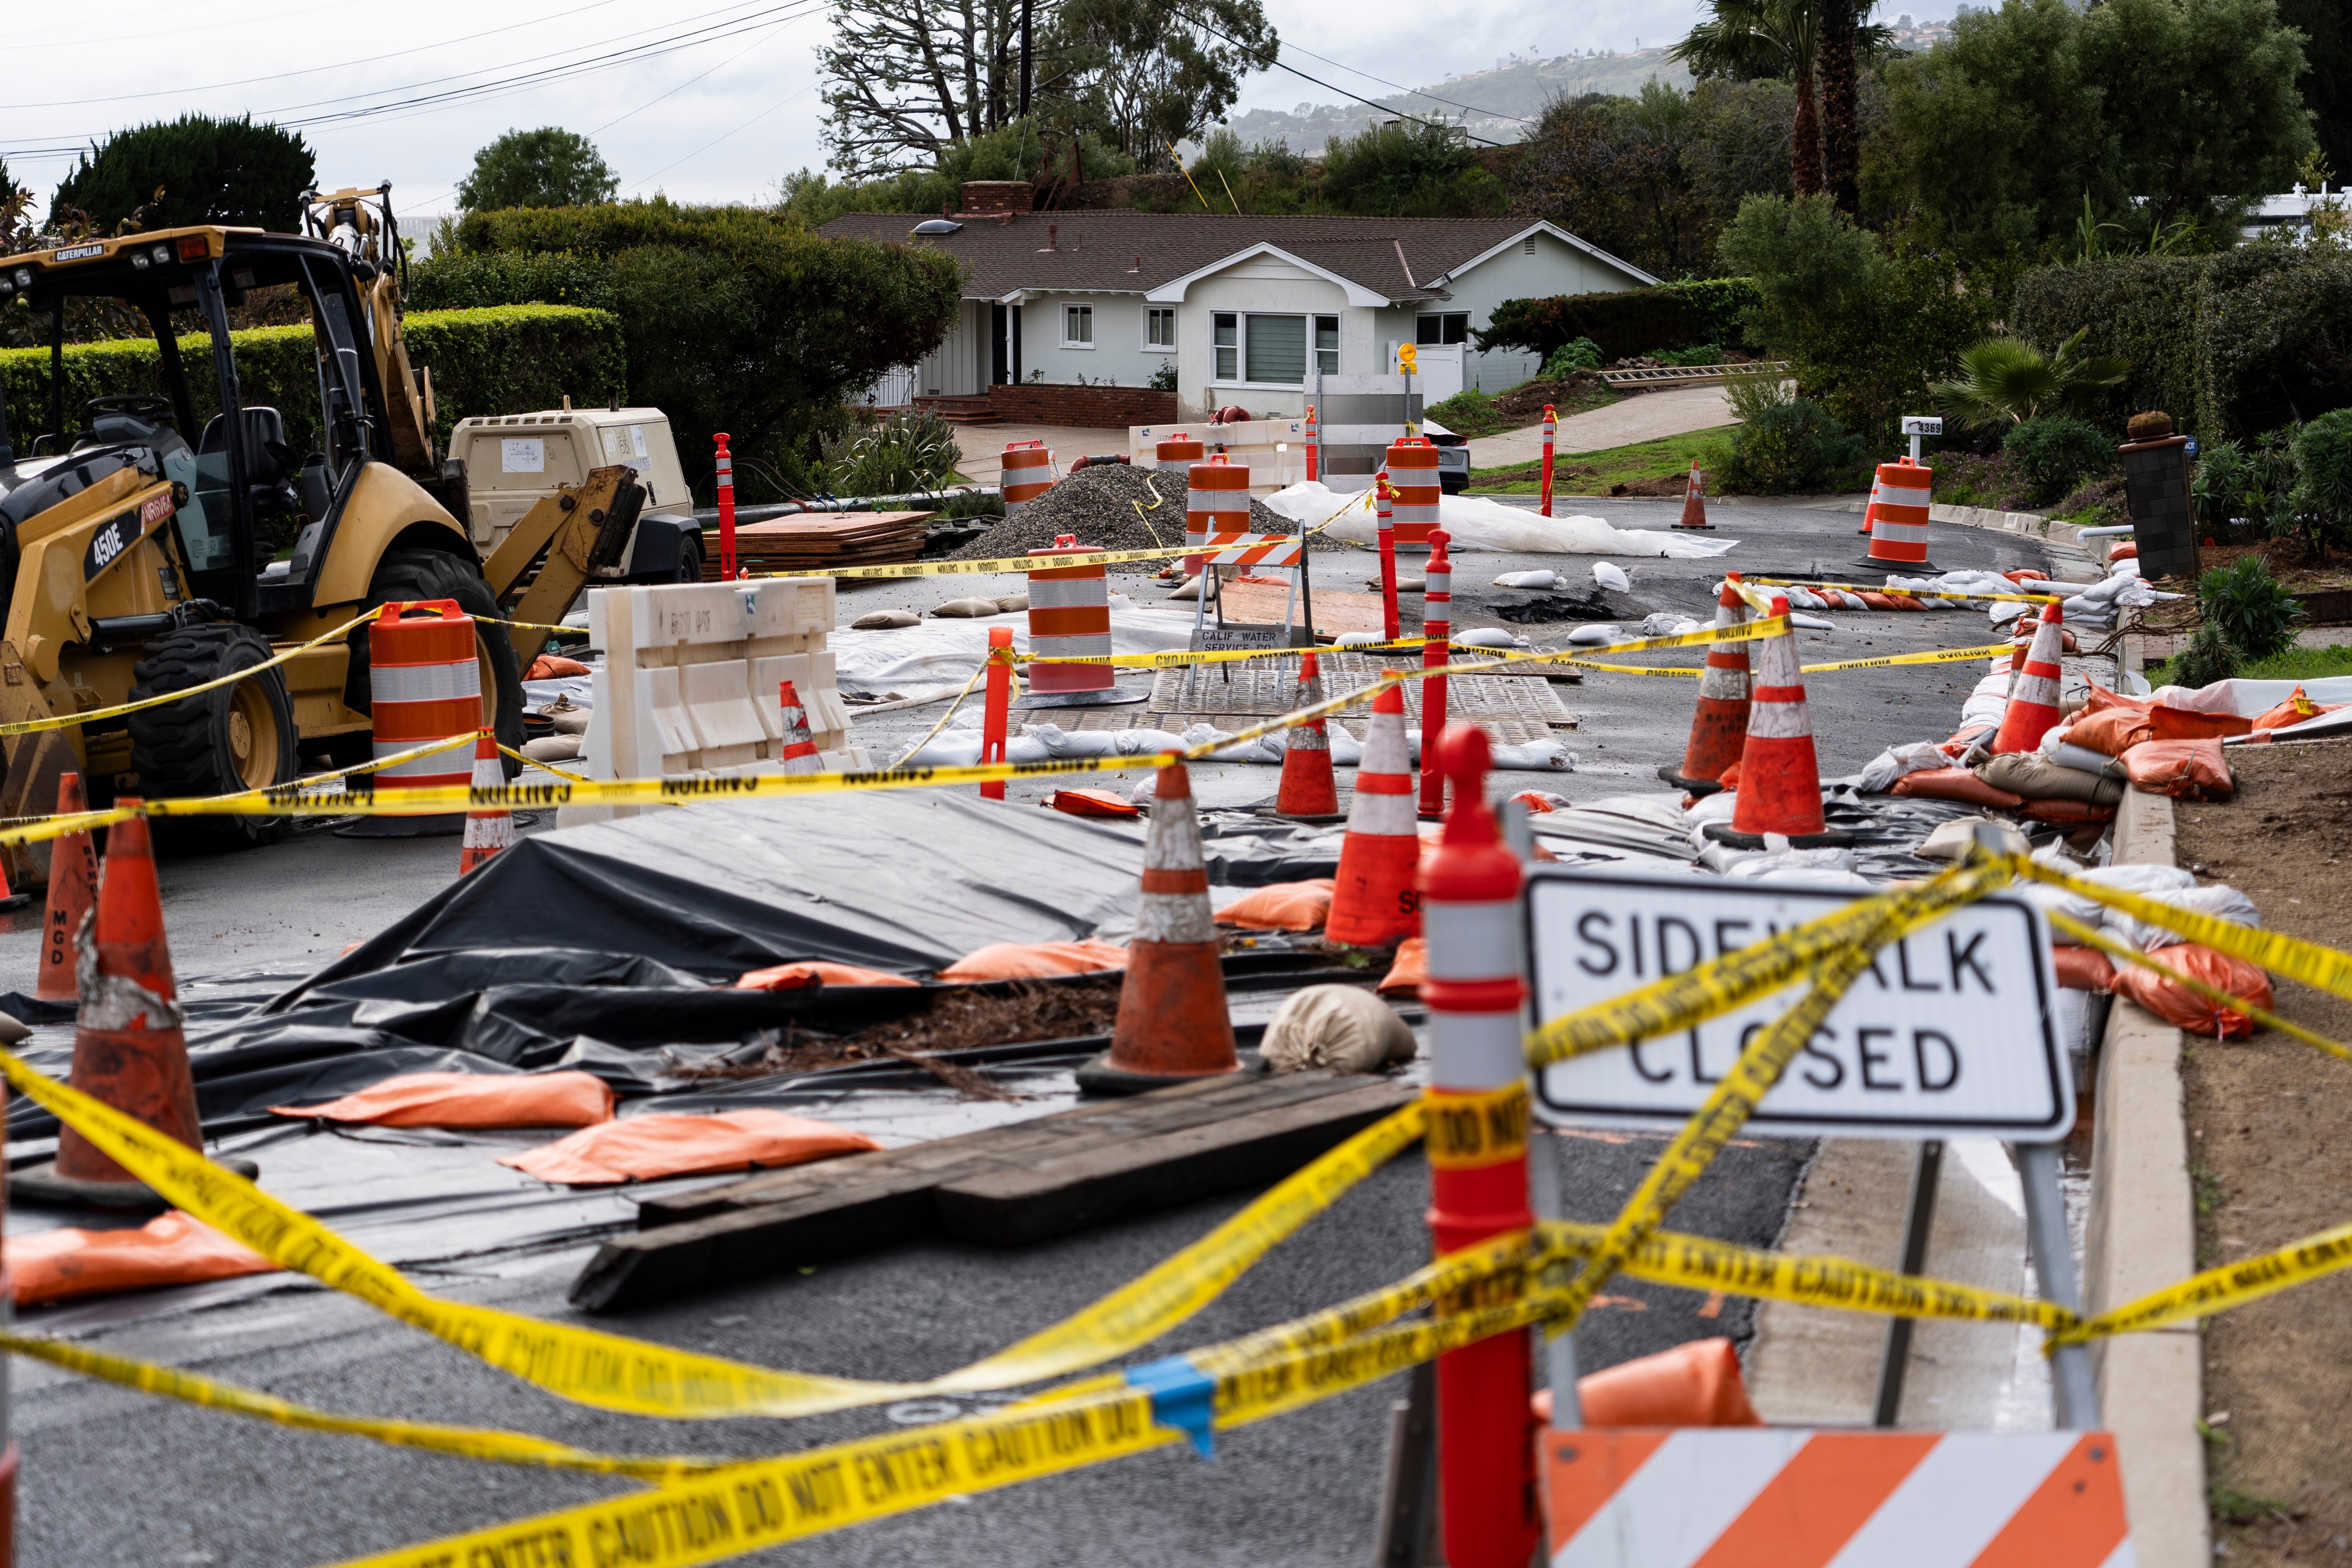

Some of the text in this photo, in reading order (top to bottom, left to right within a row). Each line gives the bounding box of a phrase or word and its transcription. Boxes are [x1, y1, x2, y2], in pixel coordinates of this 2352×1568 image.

[57, 245, 102, 260] CATERPILLAR
[1918, 423, 1941, 433] 4369
[93, 523, 123, 566] 450E
[1087, 554, 1108, 564] CAUTION
[1127, 551, 1147, 560] CUIDADO
[978, 562, 998, 572] CUIDADO
[1012, 559, 1033, 570] CAUTION
[1053, 557, 1074, 567] CUIDADO
[862, 568, 883, 577] CAUTION
[902, 566, 923, 576] CUIDADO
[937, 564, 958, 574] CAUTION
[1202, 631, 1276, 642] CALIF WATER
[1204, 643, 1250, 652] SERVICE
[661, 776, 757, 796] CAUTION
[470, 784, 571, 805] CAUTION
[52, 910, 67, 965] MGD
[1575, 909, 1998, 996] SIDELK
[589, 1490, 733, 1568] CAUTION
[735, 1478, 785, 1538] DO
[787, 1458, 851, 1520] NOT
[855, 1438, 954, 1504] ENTER
[961, 1404, 1094, 1477] CAUTION
